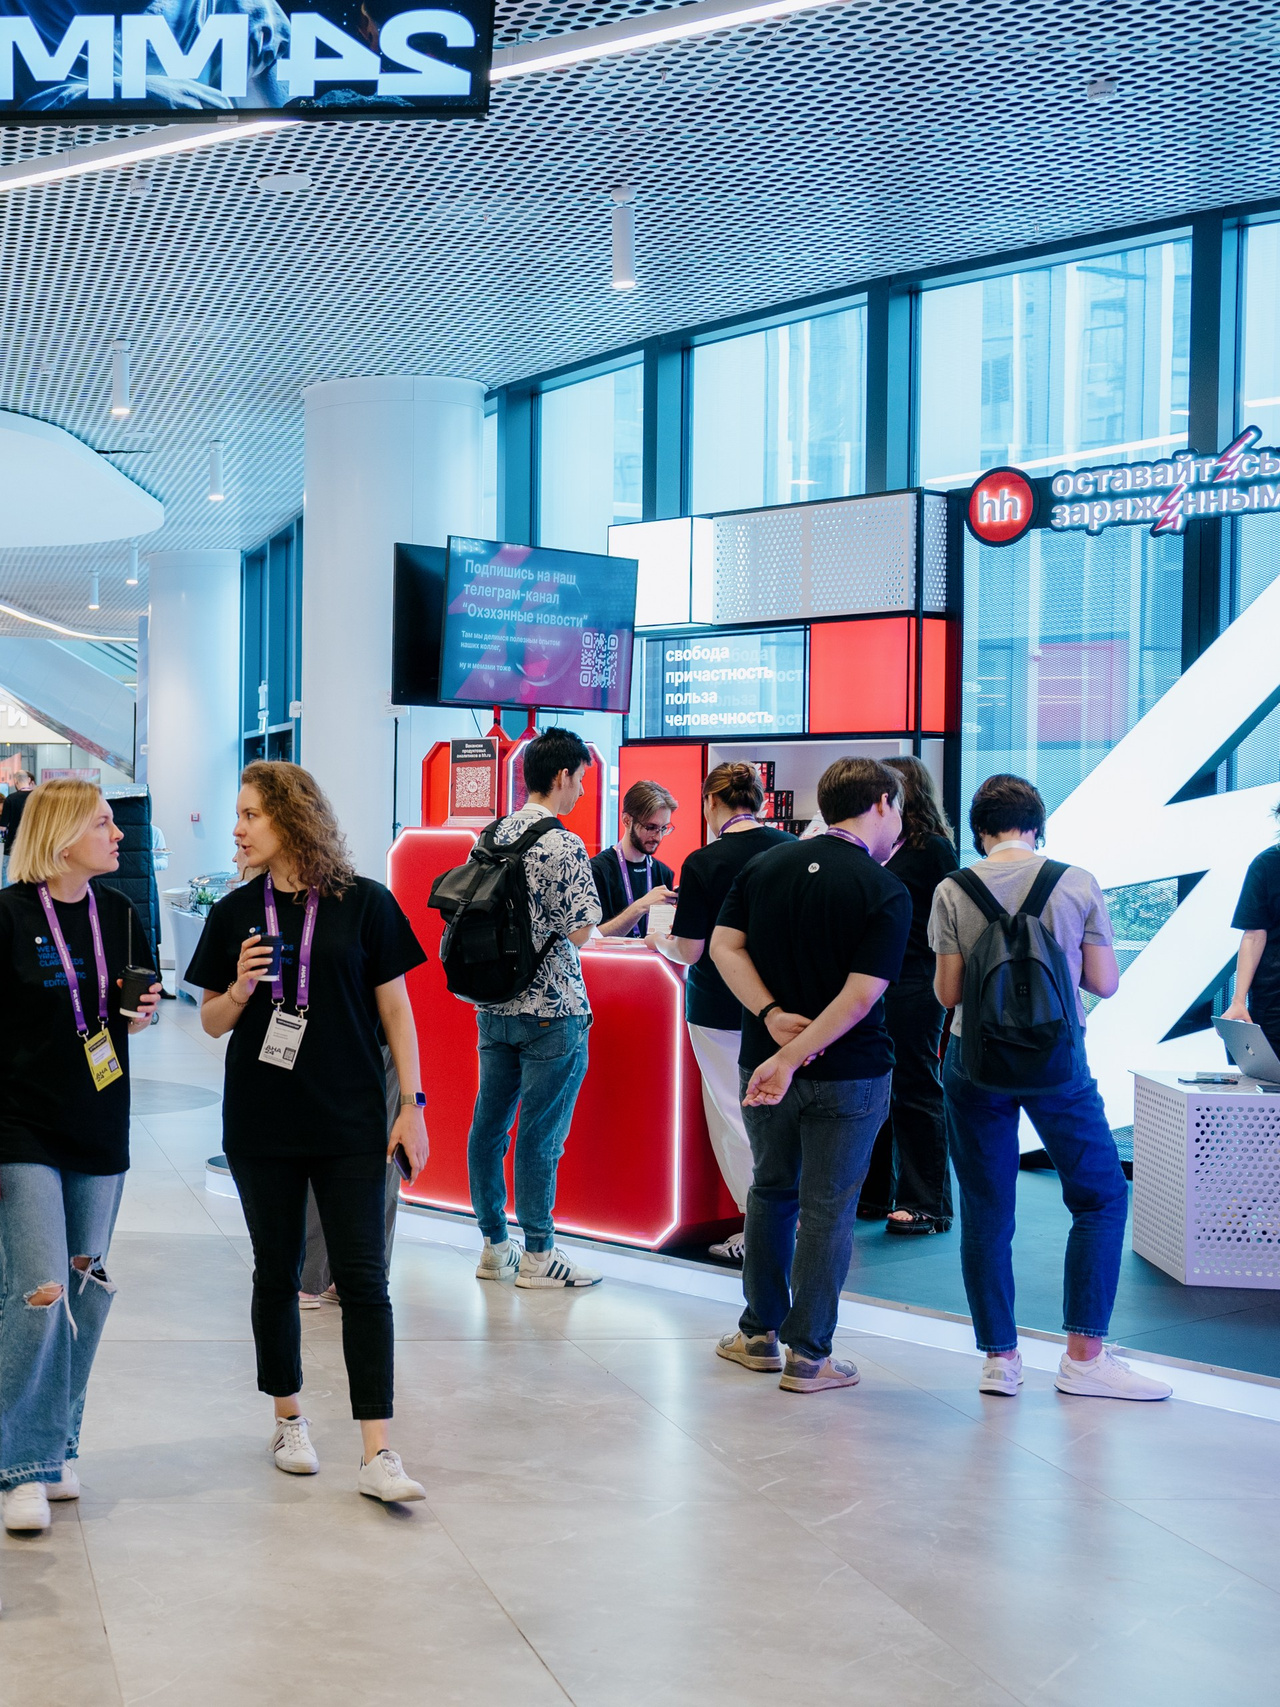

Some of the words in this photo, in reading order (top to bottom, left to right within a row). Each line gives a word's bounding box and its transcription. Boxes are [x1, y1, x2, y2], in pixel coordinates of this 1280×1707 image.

[977, 488, 1022, 523] hh
[465, 559, 534, 580] Подпишись
[537, 570, 551, 583] на
[553, 572, 576, 586] наш
[464, 583, 560, 605] телеграм-канал
[460, 641, 480, 649] наших
[462, 630, 473, 639] Там
[484, 634, 509, 642] делимся
[509, 637, 538, 645] полезным
[538, 638, 561, 647] опытом
[666, 646, 730, 662] свобода
[459, 662, 467, 670] ну
[665, 666, 775, 687] причастность
[665, 691, 718, 705] польза
[665, 712, 775, 726] человечность
[43, 979, 68, 988] EDITIO
[264, 1045, 282, 1054] AHA
